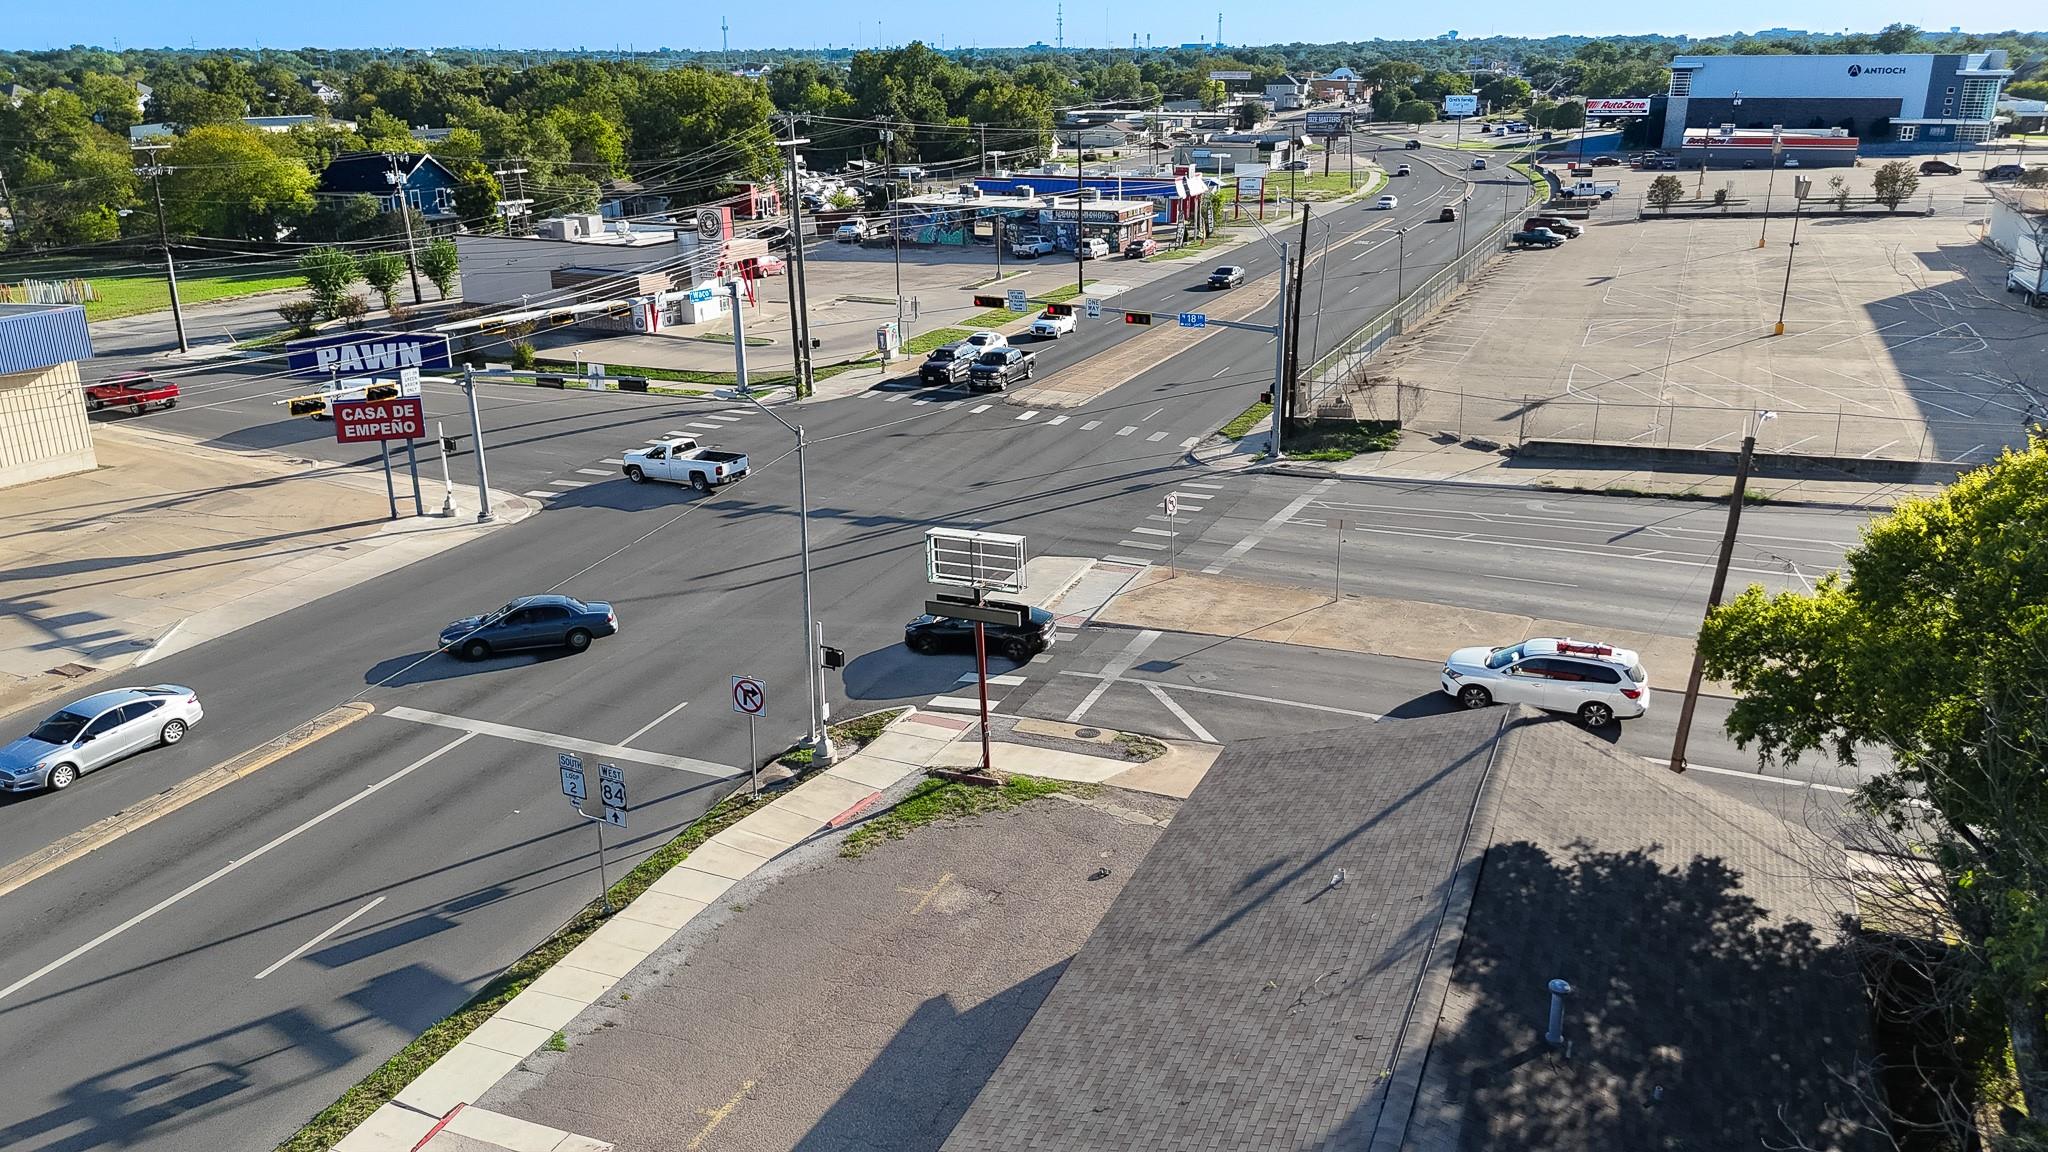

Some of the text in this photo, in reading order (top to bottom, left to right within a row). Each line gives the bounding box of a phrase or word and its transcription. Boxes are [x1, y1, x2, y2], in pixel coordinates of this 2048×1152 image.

[1601, 100, 1646, 109] AutoZone
[693, 289, 710, 299] Waco
[316, 342, 422, 372] PAWN
[341, 404, 415, 421] CASA DE
[344, 419, 416, 437] EMPEÑO
[560, 756, 582, 770] SOUTH
[601, 766, 621, 780] WEST
[569, 781, 577, 794] 2
[603, 785, 624, 804] 84
